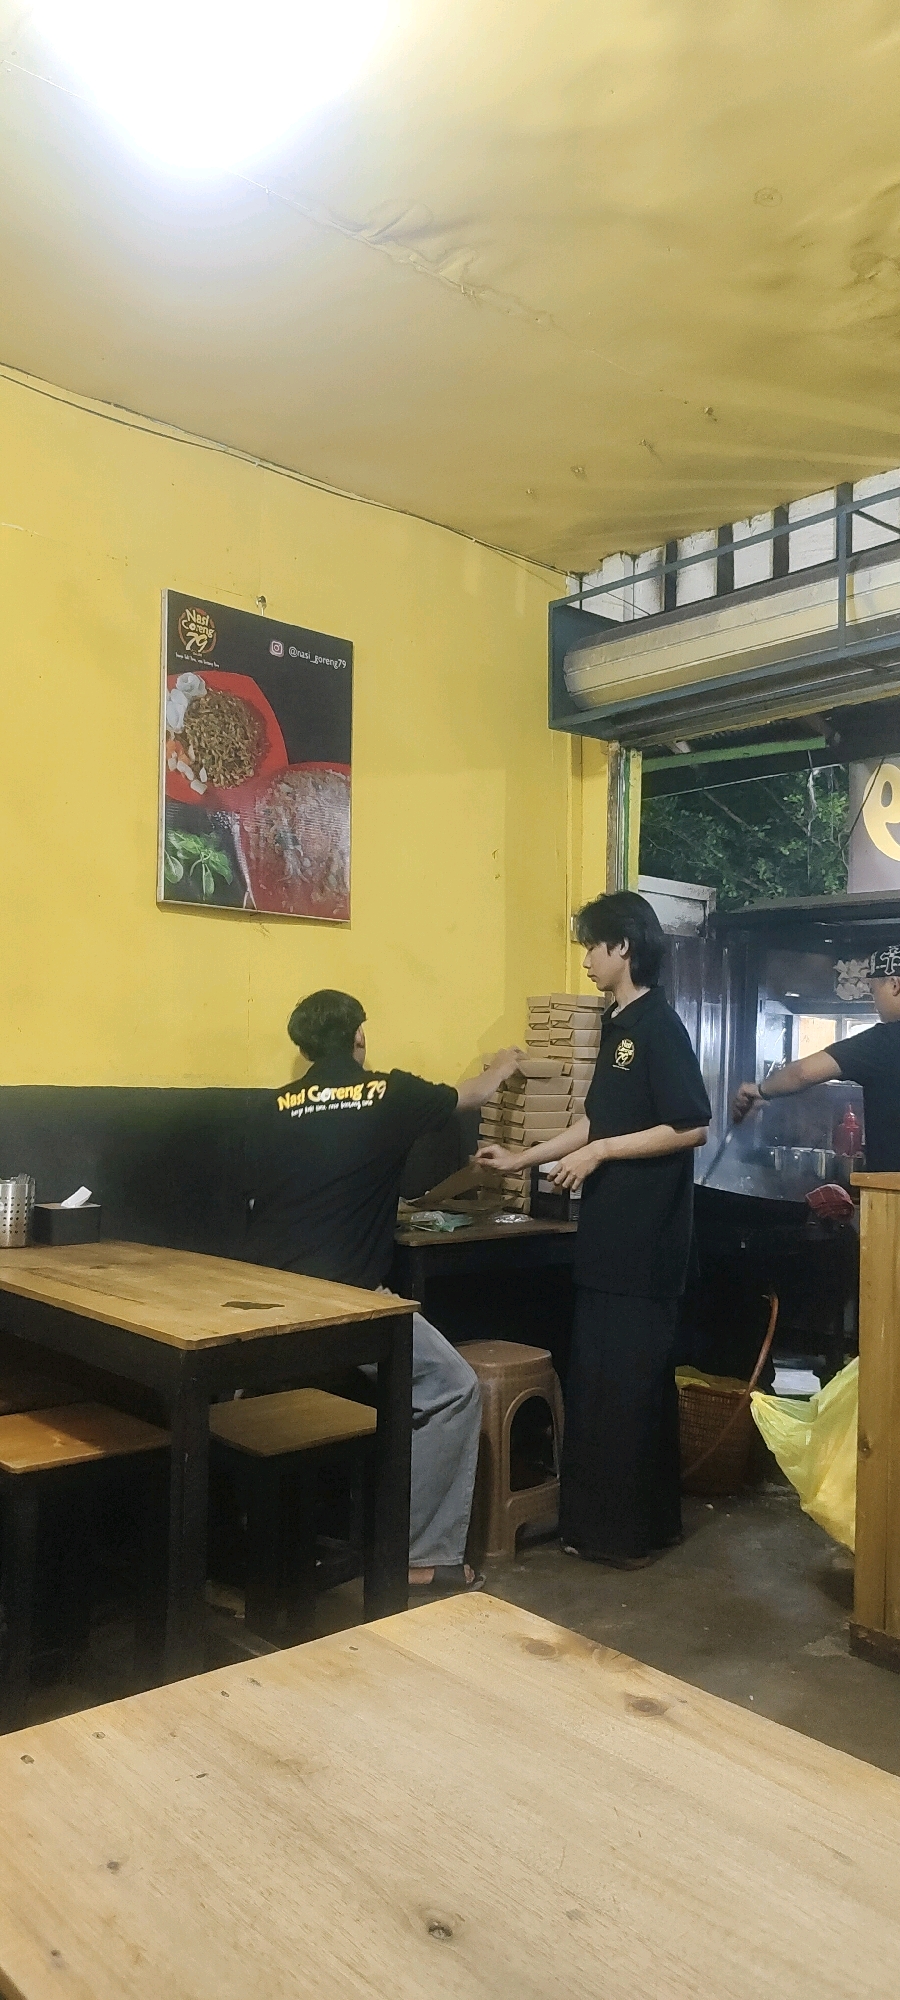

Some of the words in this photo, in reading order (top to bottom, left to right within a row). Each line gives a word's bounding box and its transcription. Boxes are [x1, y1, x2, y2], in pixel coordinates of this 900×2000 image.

[185, 609, 210, 626] Nasi
[186, 631, 208, 652] 79
[288, 646, 347, 669] @nasi_goreng79
[277, 1088, 306, 1111] Nasi
[307, 1083, 365, 1103] Goreng
[366, 1080, 387, 1100] 79
